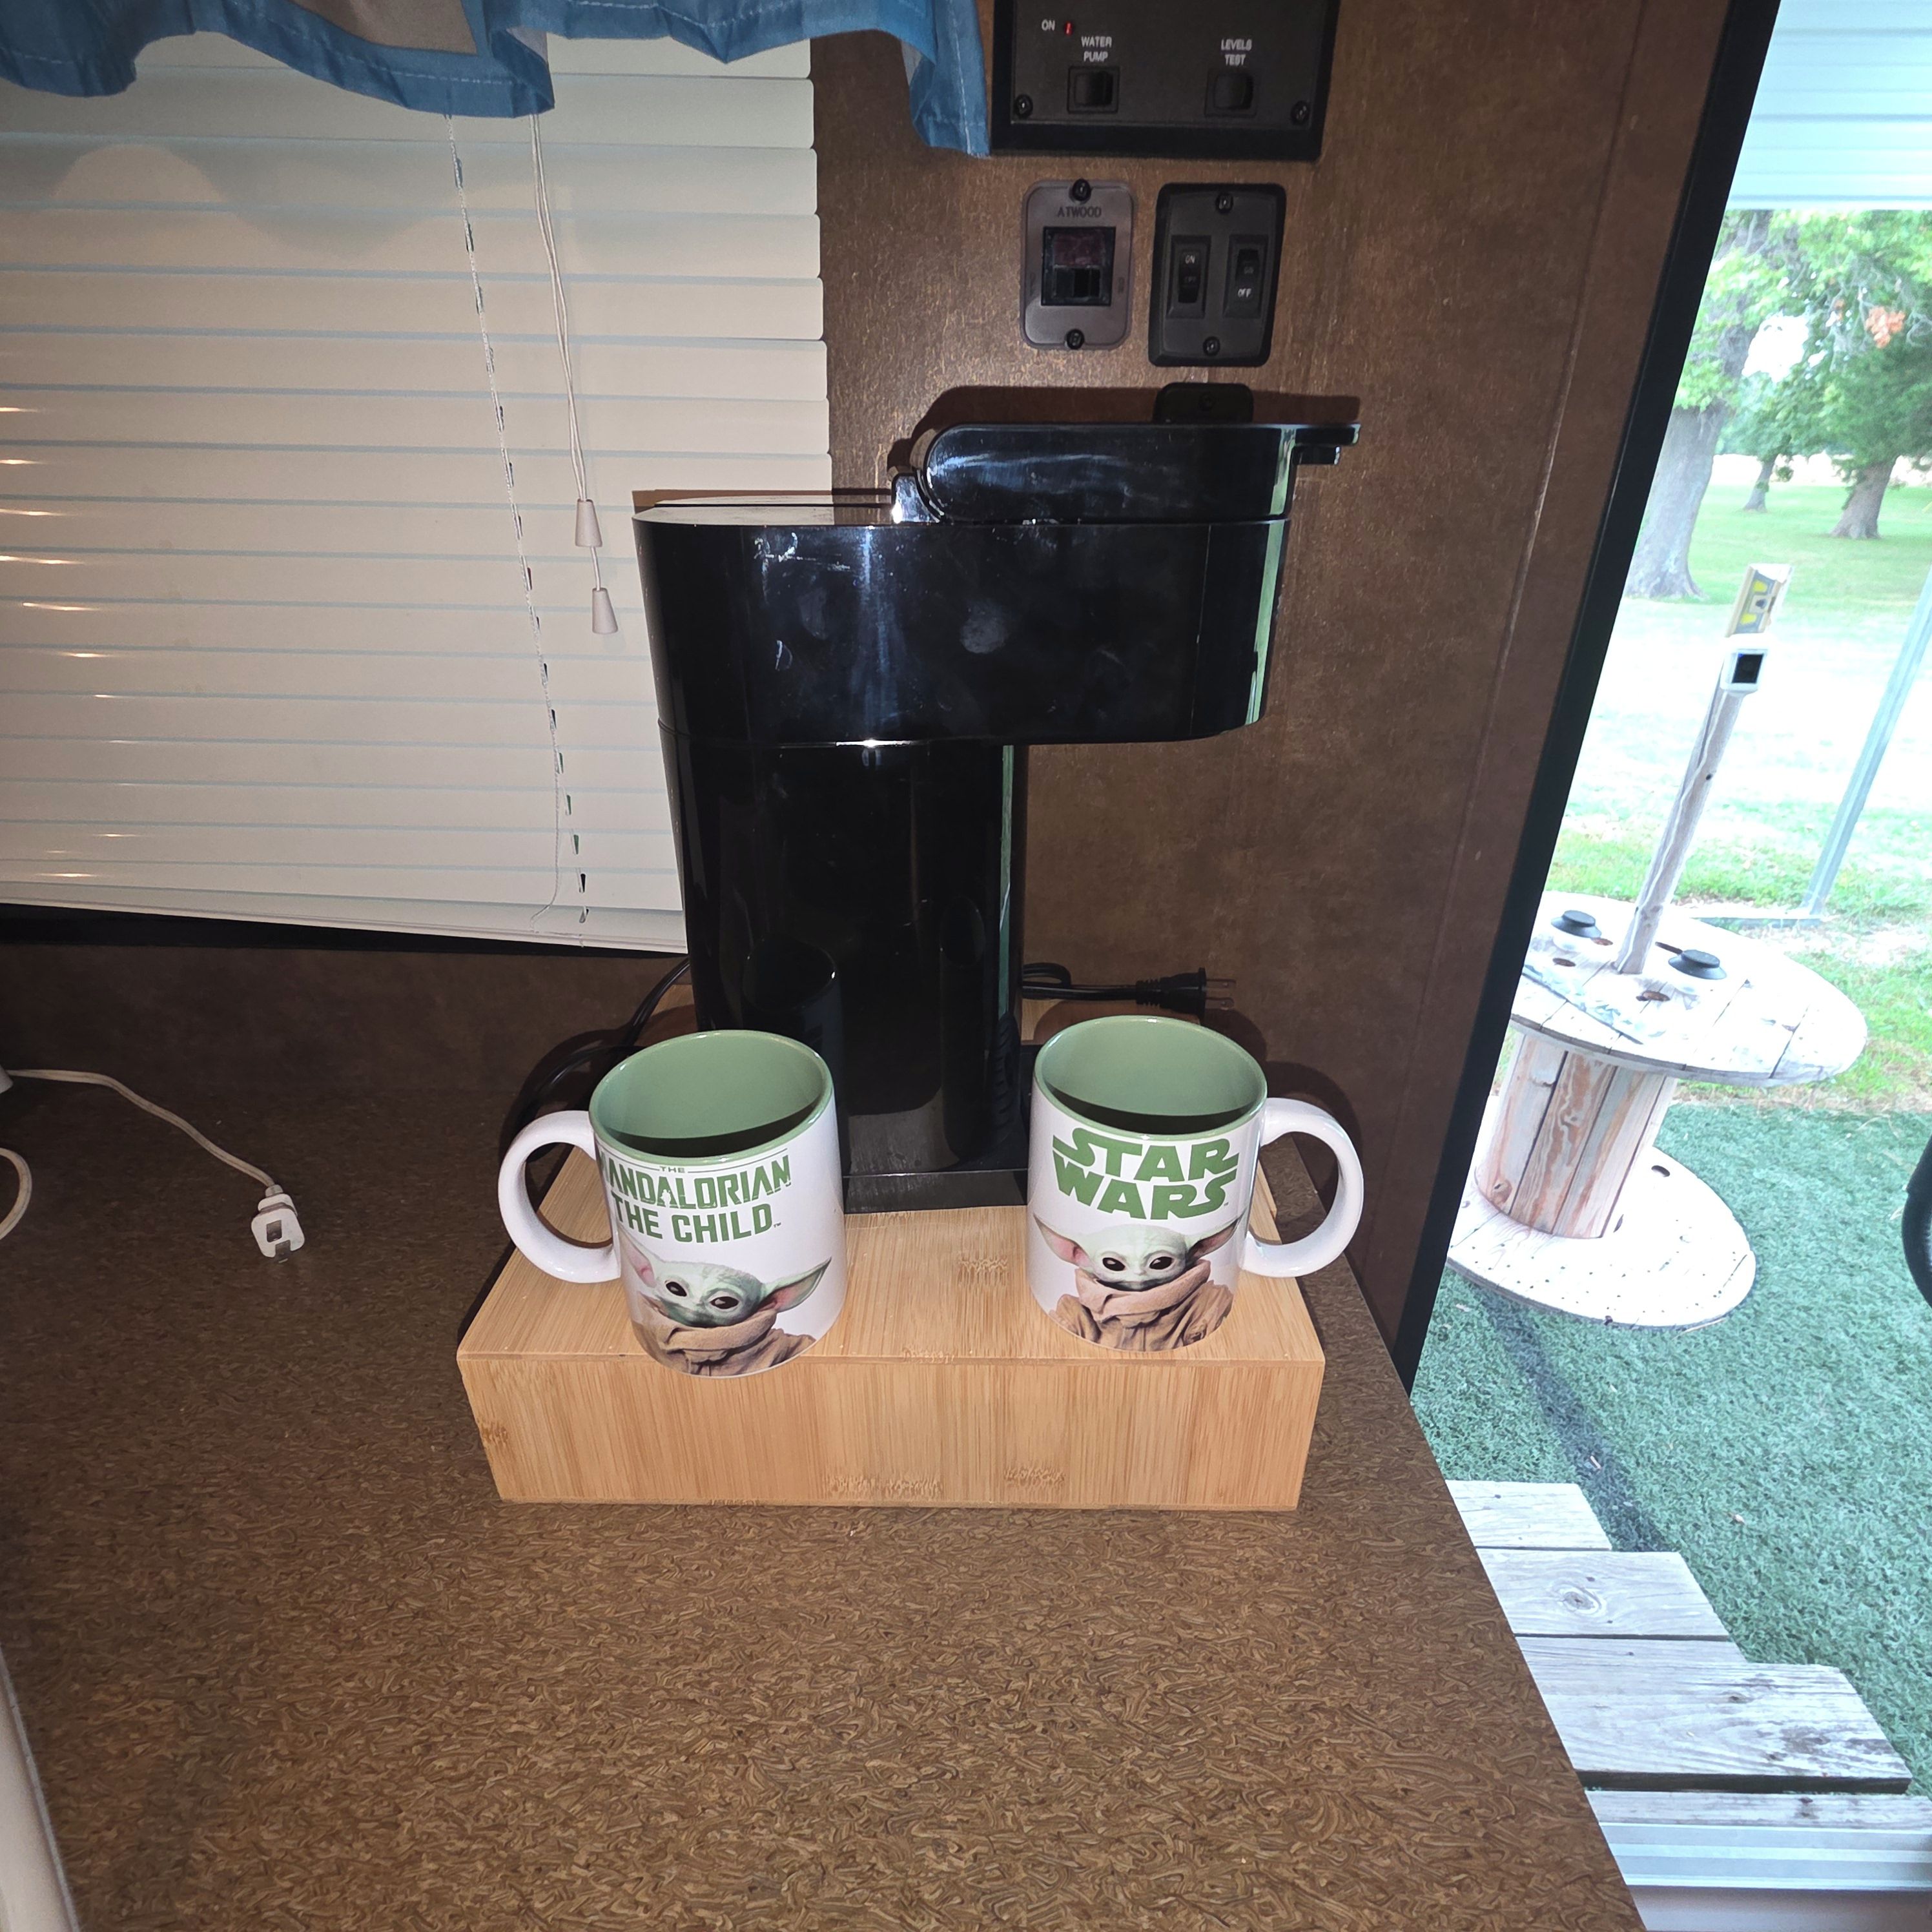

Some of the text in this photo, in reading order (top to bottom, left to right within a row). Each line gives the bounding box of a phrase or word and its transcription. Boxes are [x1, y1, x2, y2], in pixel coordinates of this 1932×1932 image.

[1042, 20, 1055, 31] ON
[1081, 37, 1112, 48] WATER
[1220, 39, 1251, 51] LEVELS
[1084, 51, 1108, 62] PUMP
[1225, 53, 1246, 65] TEST
[1057, 207, 1102, 218] ATWOOD
[1237, 288, 1251, 298] OFF
[1053, 1127, 1240, 1182] STAR
[1053, 1150, 1238, 1220] WARS
[611, 1190, 663, 1239] THE
